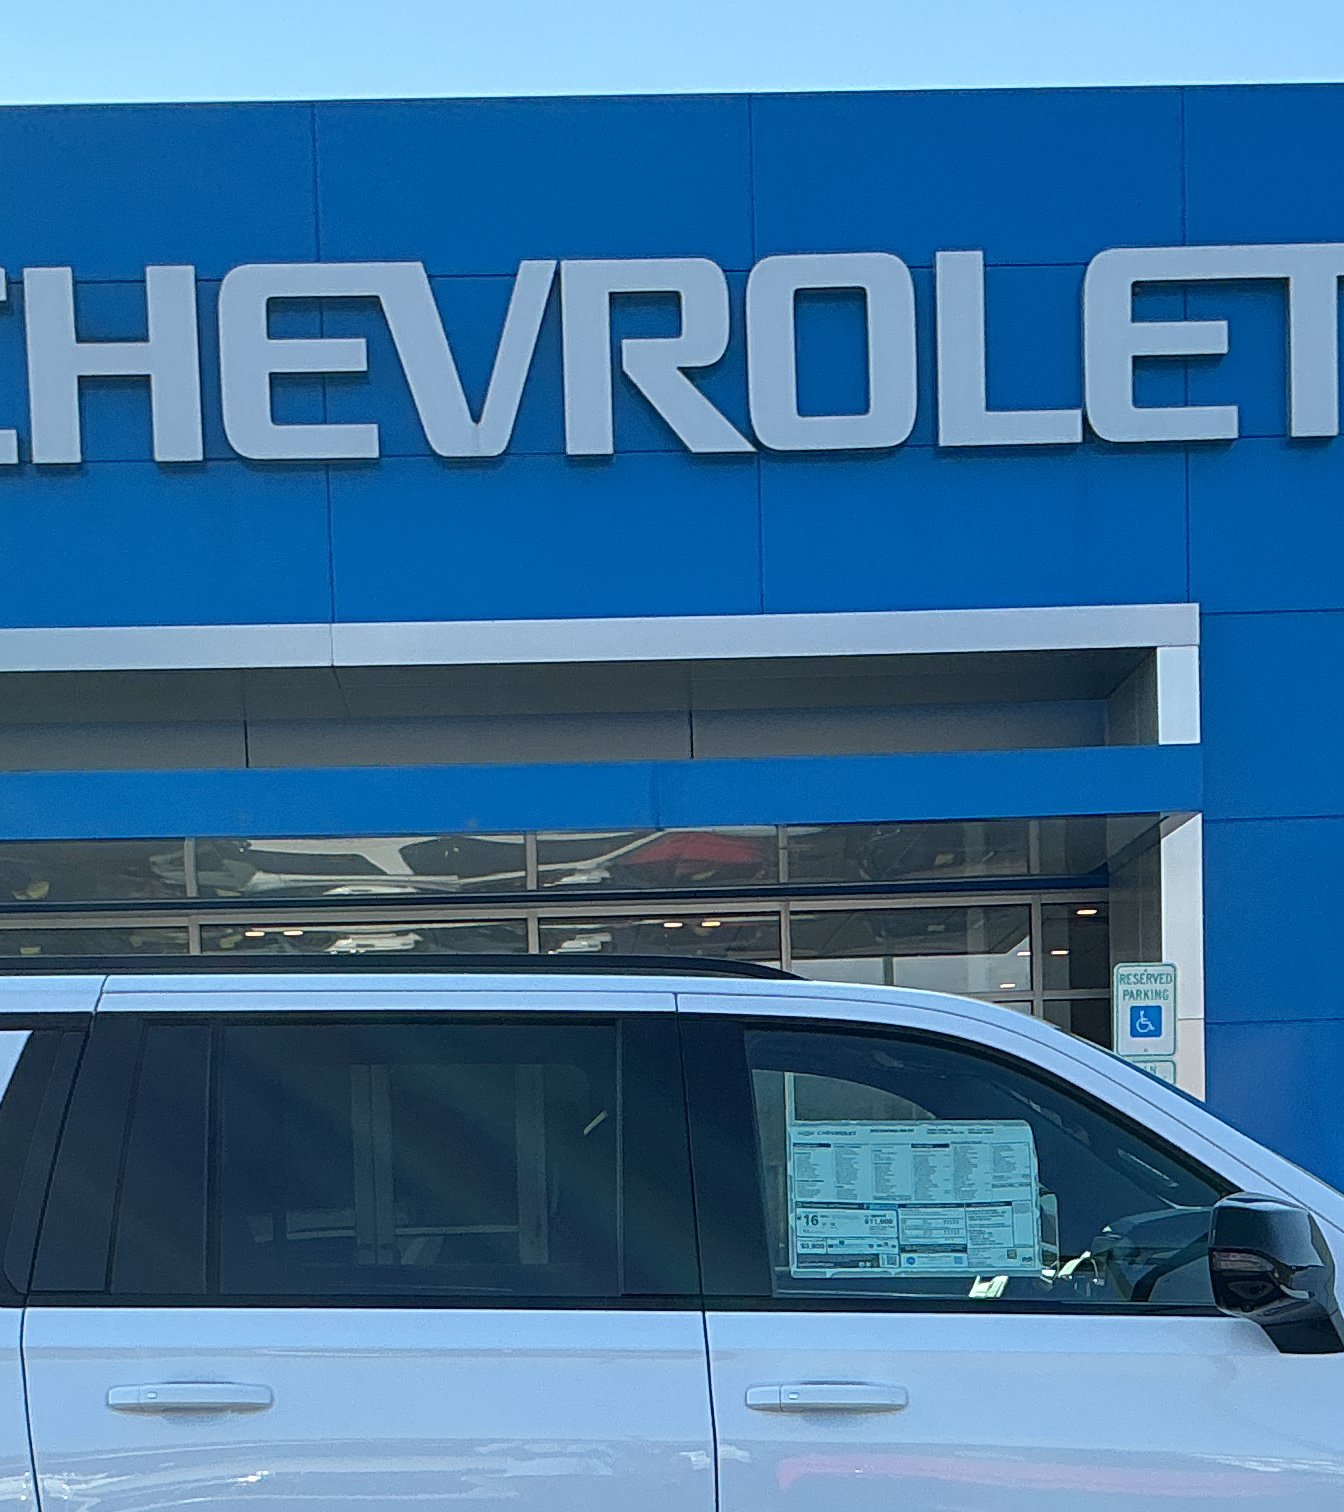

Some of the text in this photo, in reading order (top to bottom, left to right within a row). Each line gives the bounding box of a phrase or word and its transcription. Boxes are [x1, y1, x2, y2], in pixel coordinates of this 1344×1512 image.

[1119, 972, 1173, 986] RESERVED
[1122, 988, 1170, 1001] PARKING
[803, 1214, 819, 1227] 16
